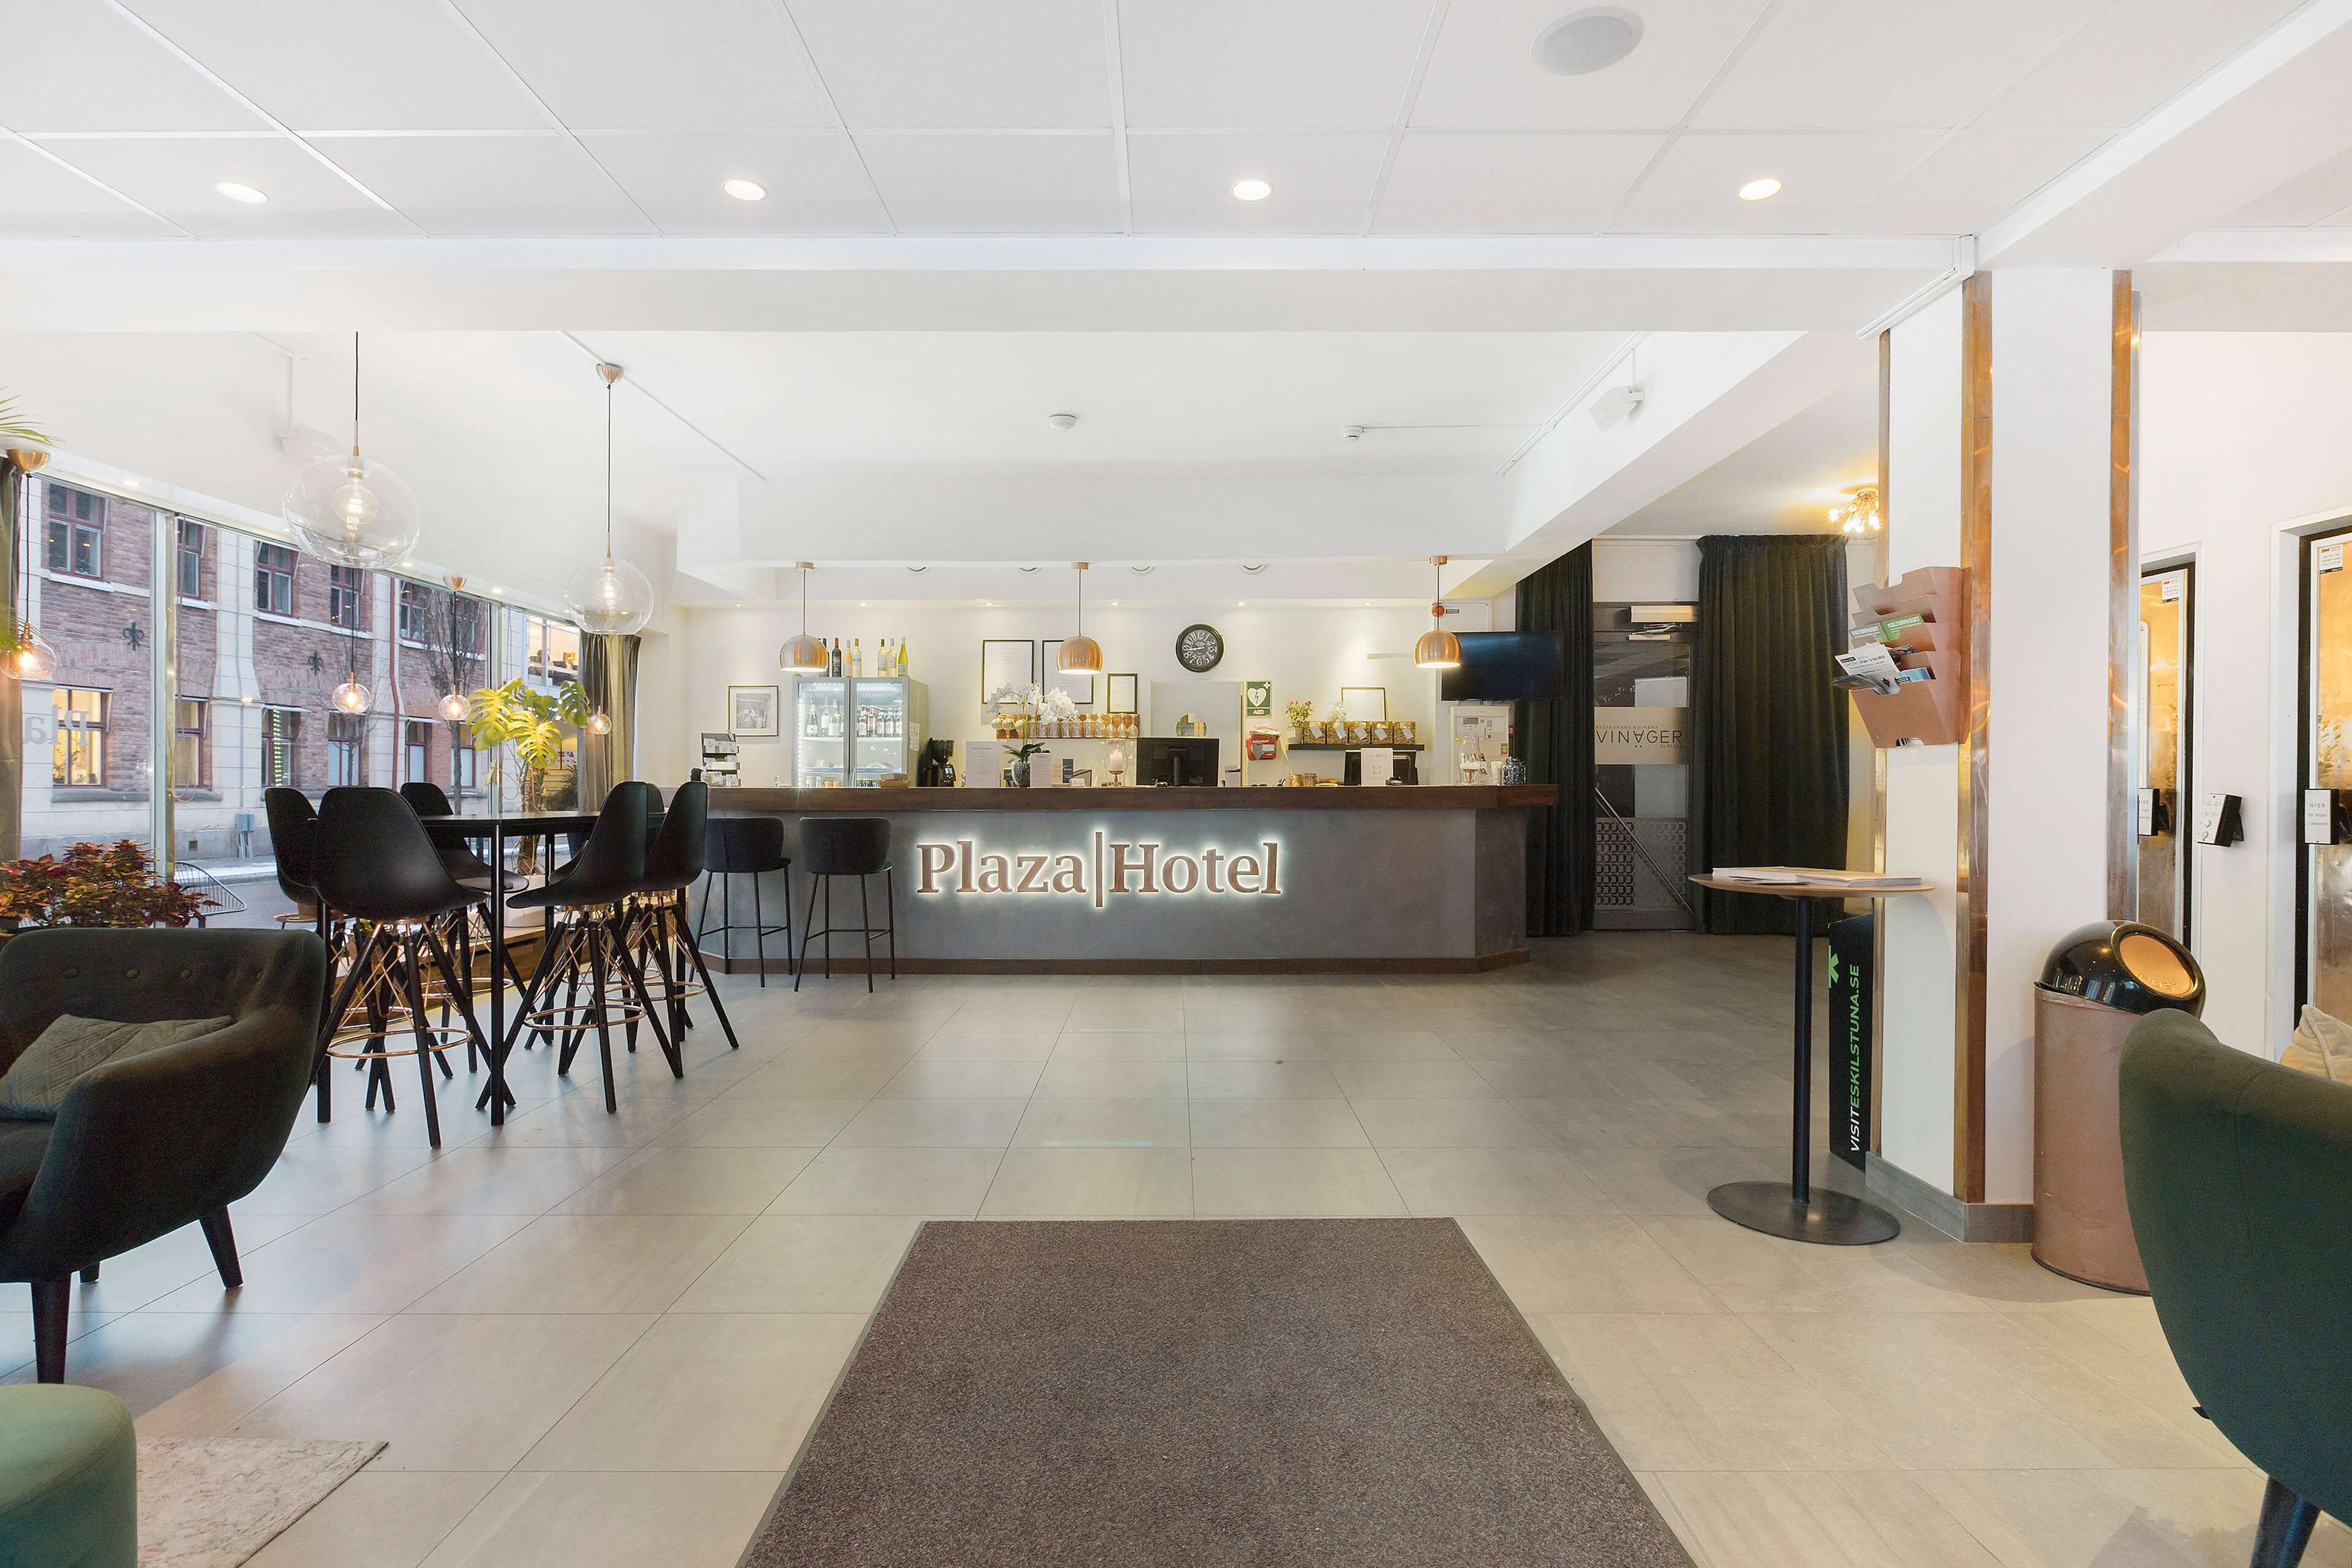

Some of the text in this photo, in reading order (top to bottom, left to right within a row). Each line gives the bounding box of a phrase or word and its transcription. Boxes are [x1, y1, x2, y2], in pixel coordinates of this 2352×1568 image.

[1197, 631, 1205, 640] 12
[1185, 636, 1194, 645] 10
[1189, 655, 1197, 663] 7
[1202, 655, 1210, 664] 5
[1207, 651, 1216, 660] 4
[1196, 656, 1202, 666] 6
[1849, 964, 1860, 1152] VISITESKILSTUNA.SE
